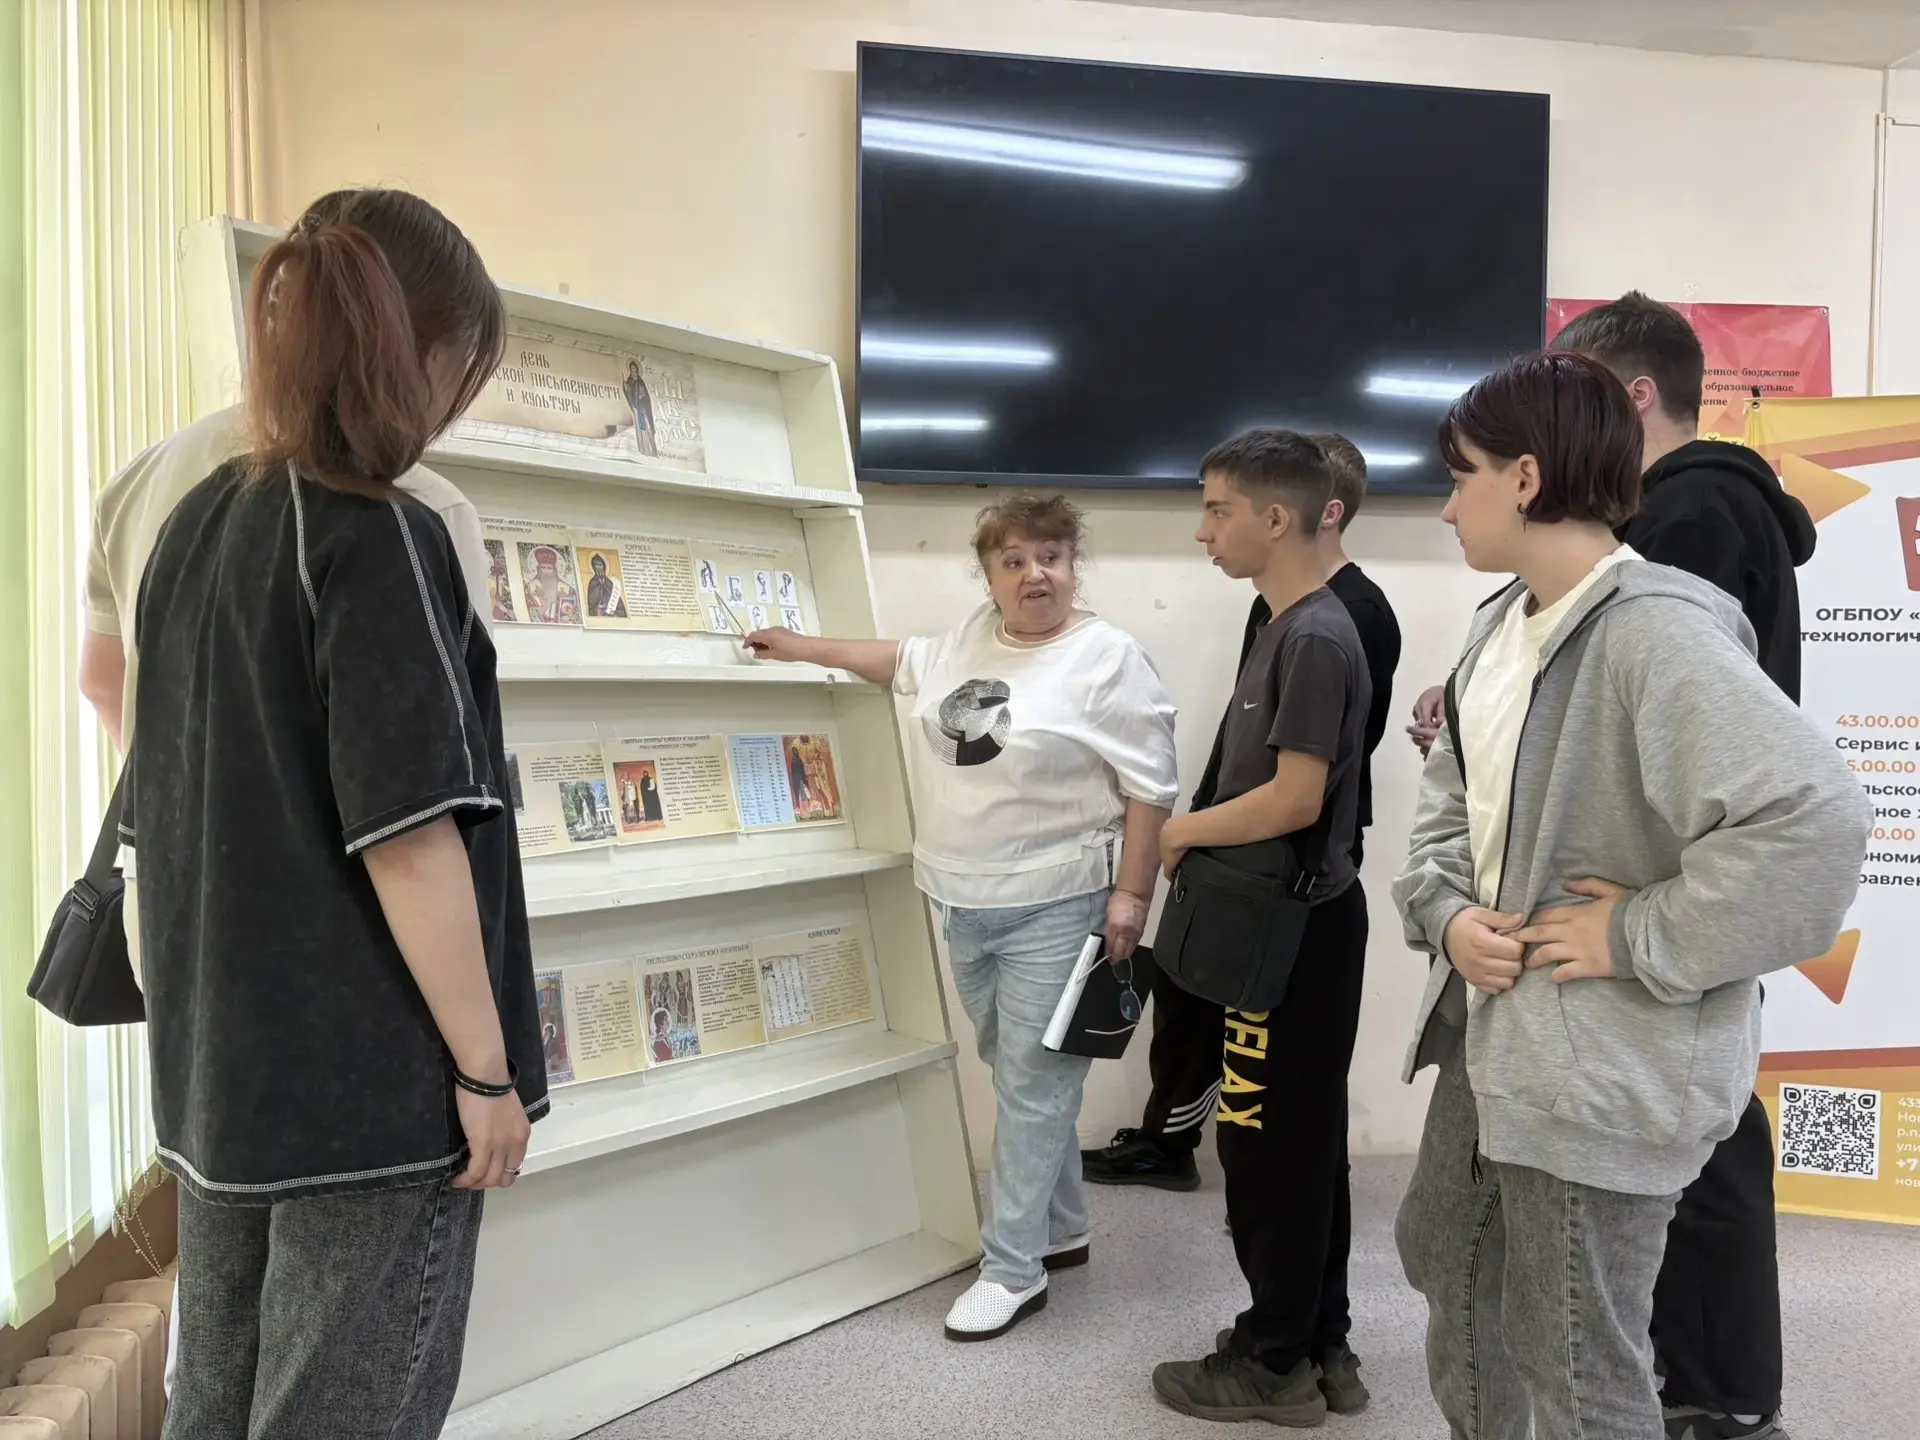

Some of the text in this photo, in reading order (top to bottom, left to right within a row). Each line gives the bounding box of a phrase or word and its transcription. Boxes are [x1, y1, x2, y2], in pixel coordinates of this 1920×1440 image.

[1741, 367, 1801, 378] бюджетное
[1704, 381, 1794, 393] образоваельное
[1815, 608, 1903, 621] ОГБПОУ
[1836, 714, 1919, 728] 43.00.00
[1835, 736, 1910, 752] Сервис
[1845, 759, 1916, 774] 5.00.00
[1862, 784, 1920, 797] льско
[1874, 806, 1912, 819] ное
